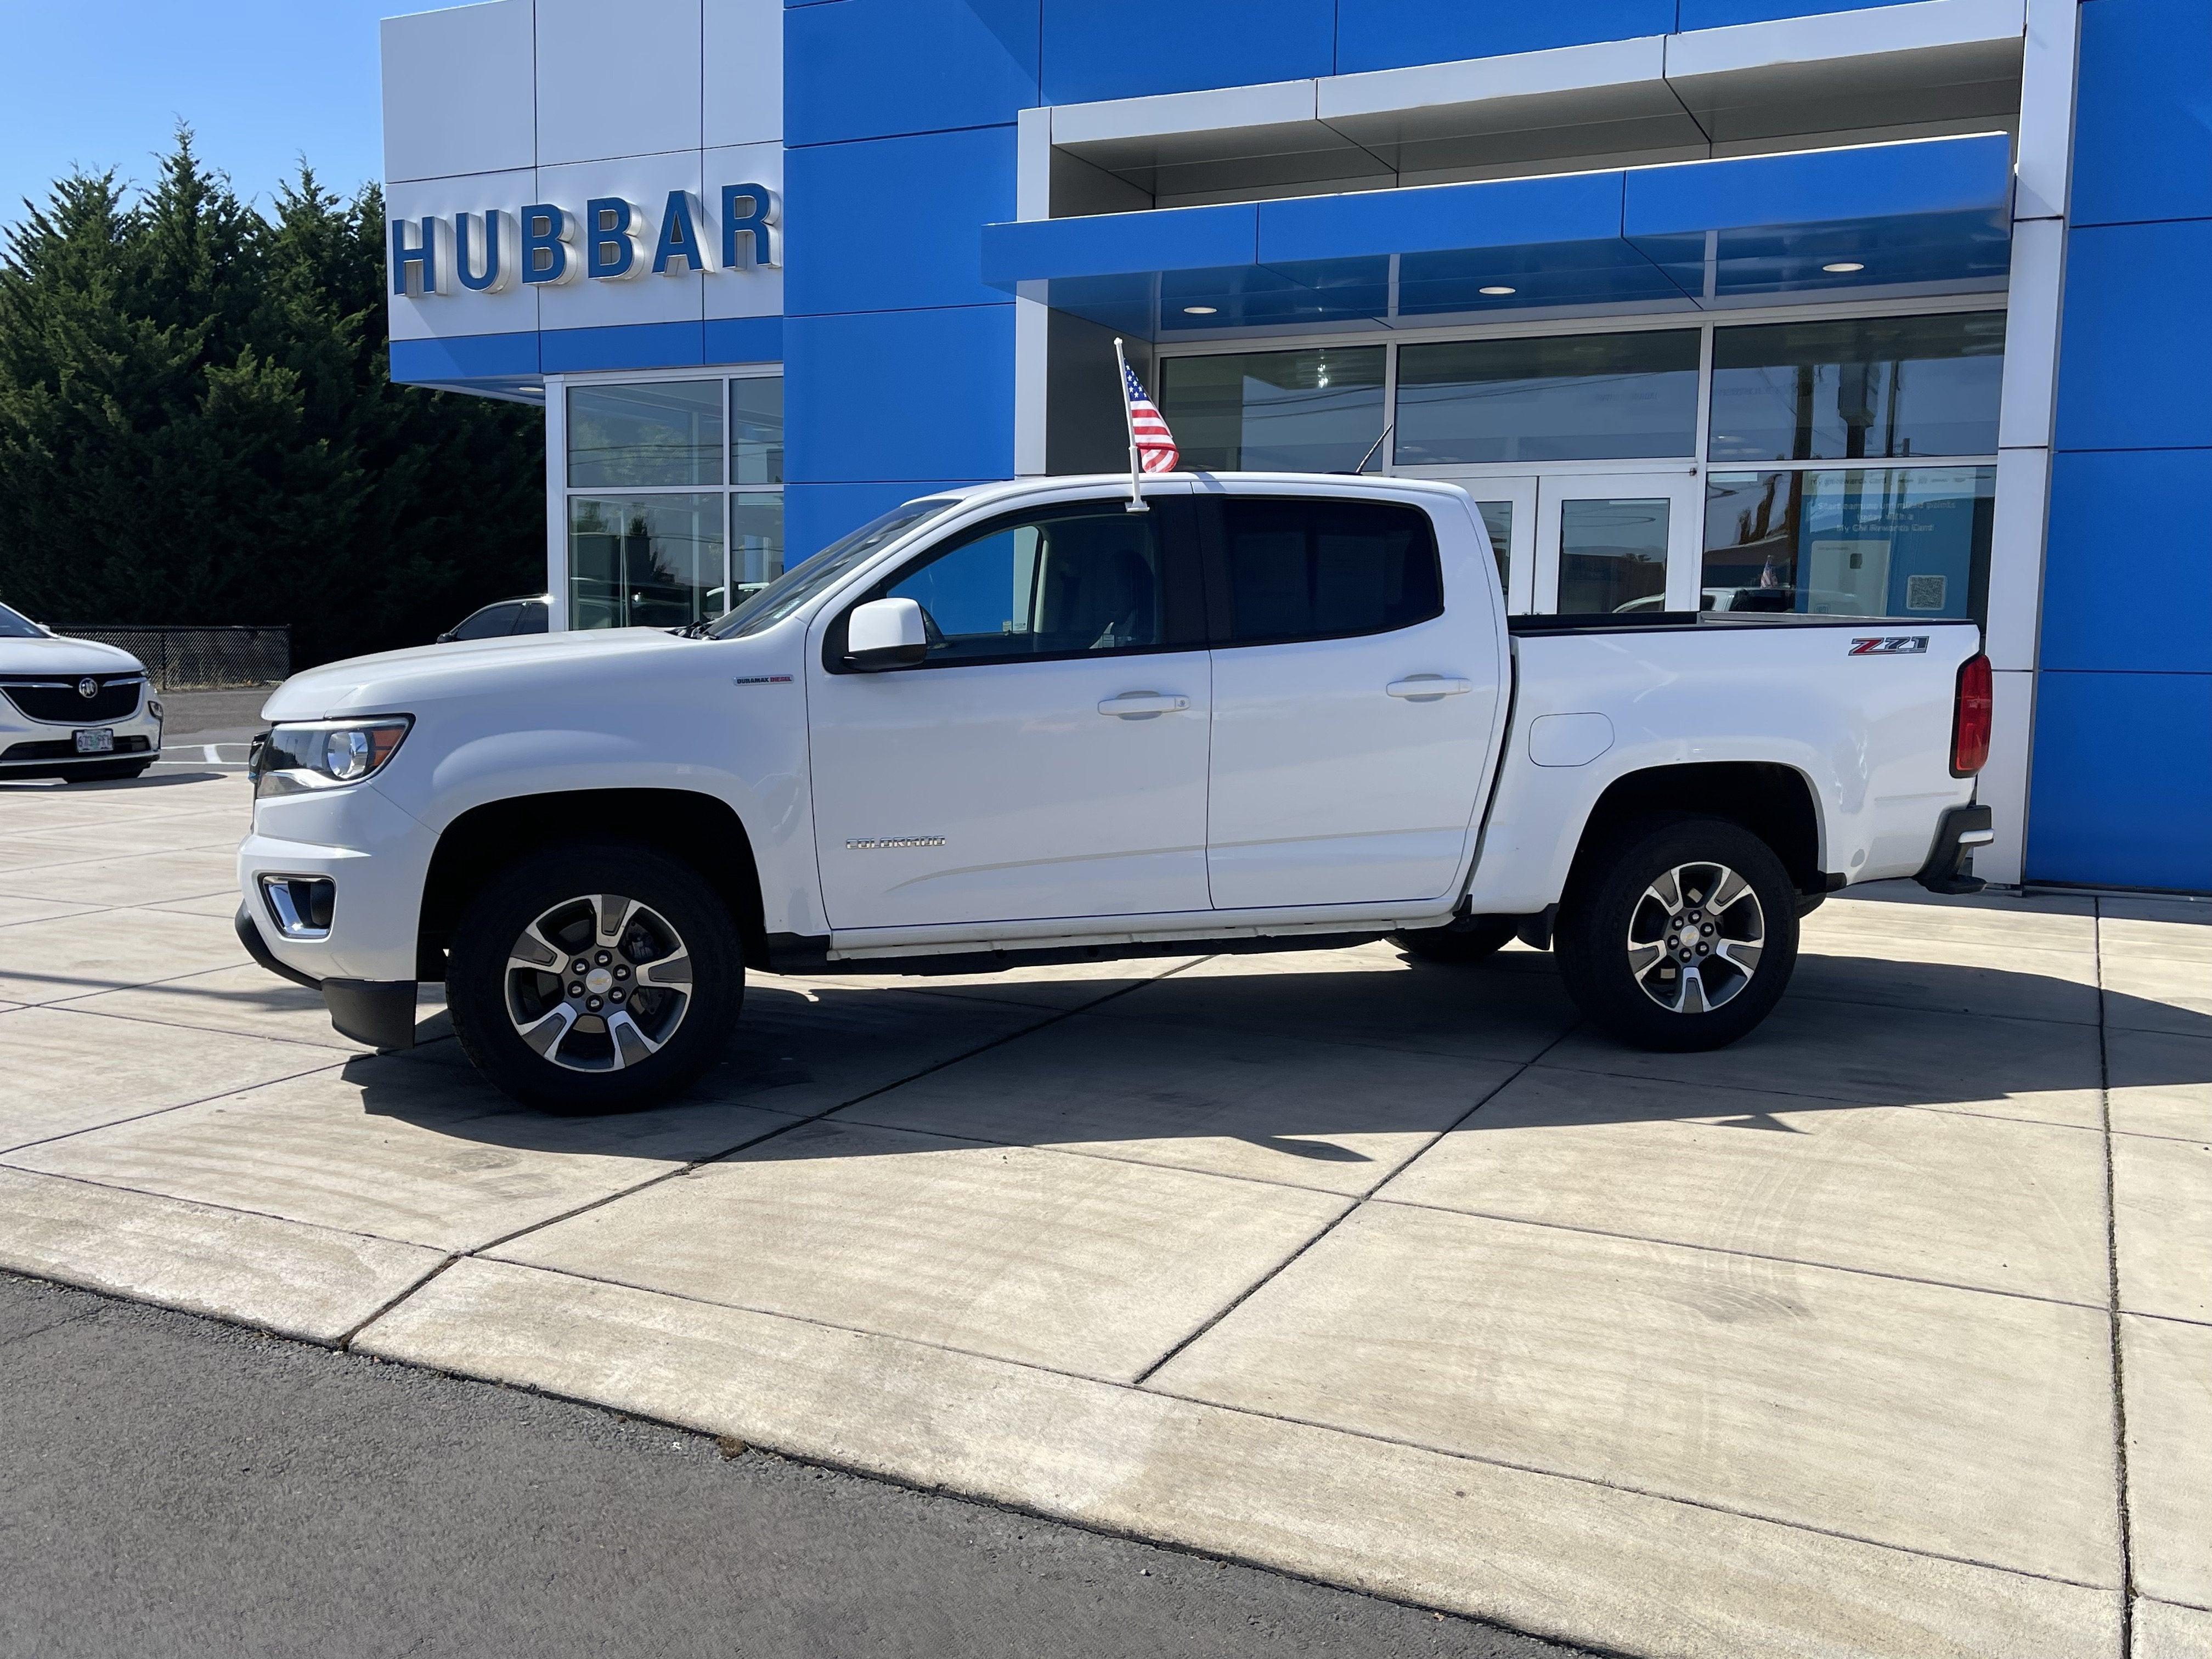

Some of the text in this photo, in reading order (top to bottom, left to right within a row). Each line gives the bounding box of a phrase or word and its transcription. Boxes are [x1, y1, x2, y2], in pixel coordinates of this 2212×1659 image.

[392, 183, 781, 297] HUBBAR
[1848, 636, 1929, 656] Z71
[845, 836, 946, 849] COLORADO
